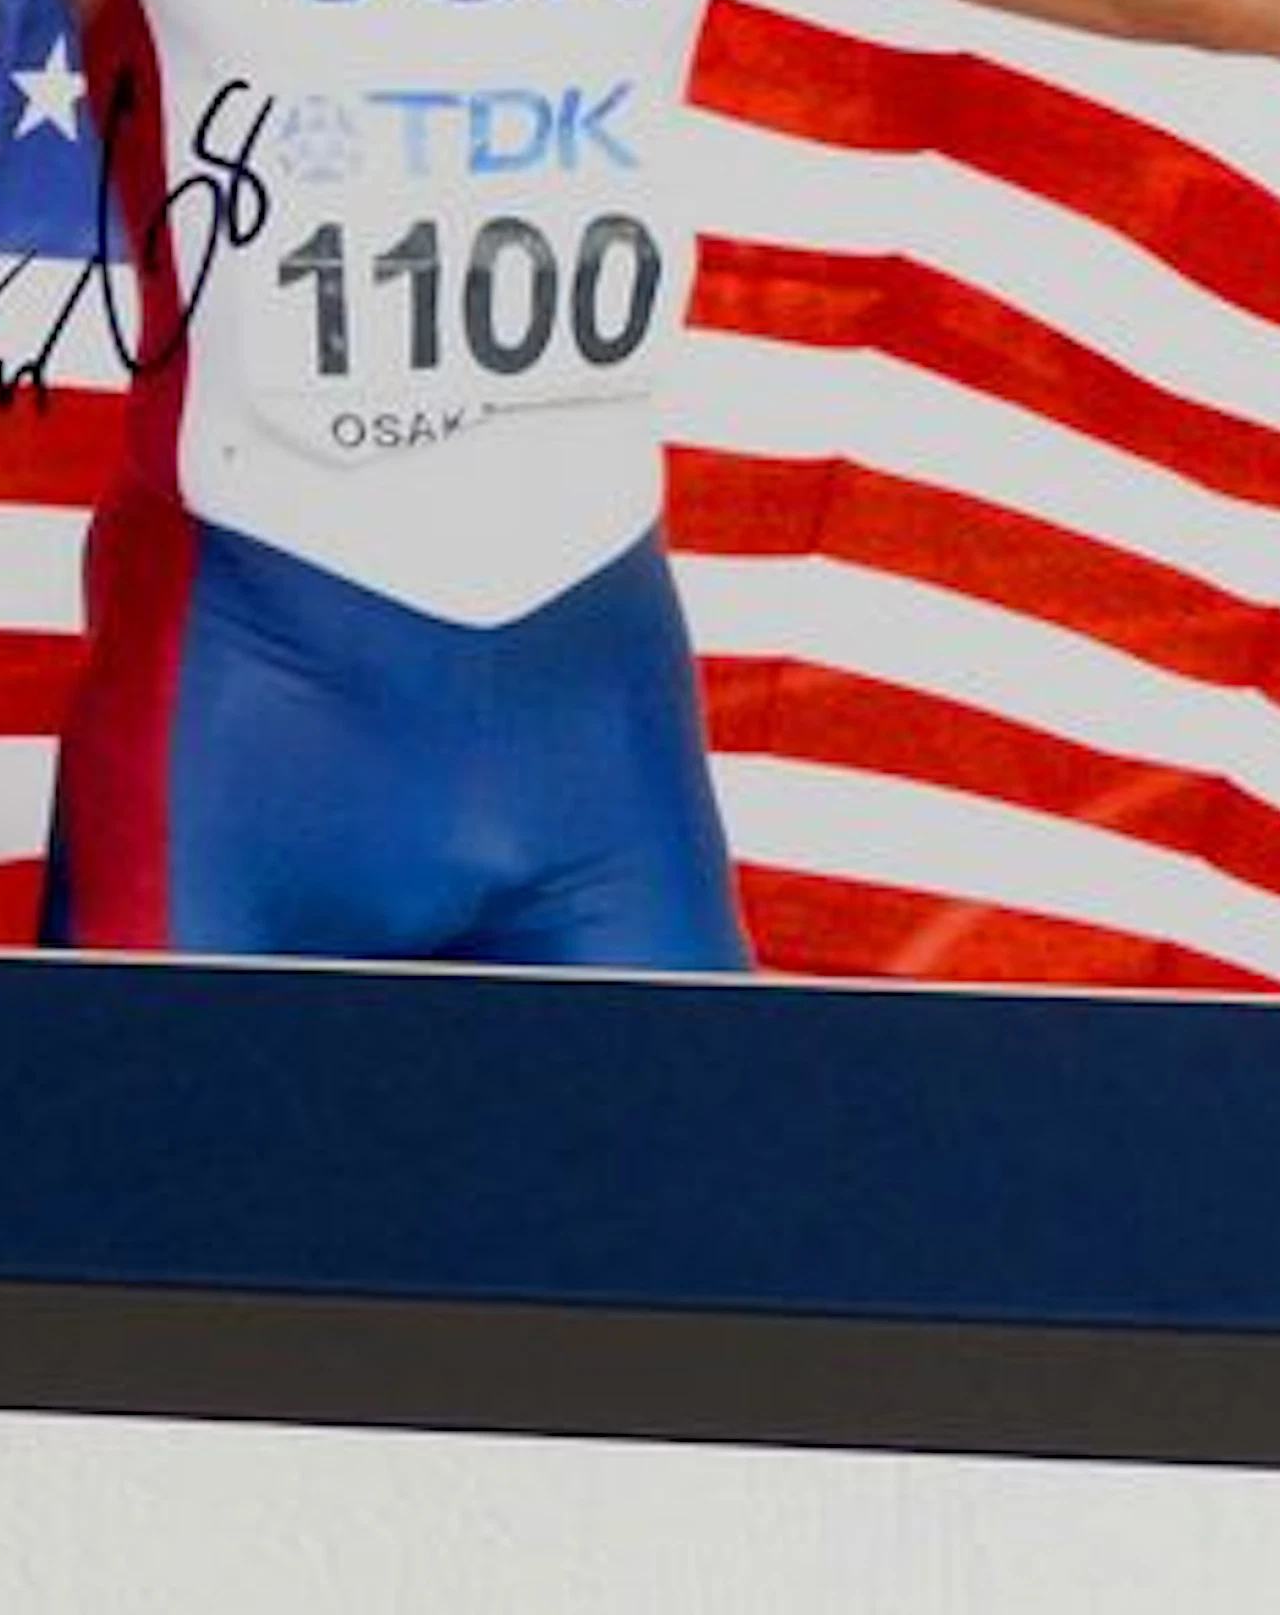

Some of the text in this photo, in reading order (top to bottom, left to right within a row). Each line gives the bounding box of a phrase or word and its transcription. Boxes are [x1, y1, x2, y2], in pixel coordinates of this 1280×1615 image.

[364, 79, 642, 176] TDK
[278, 214, 663, 377] 1100
[331, 404, 494, 449] OSAK
